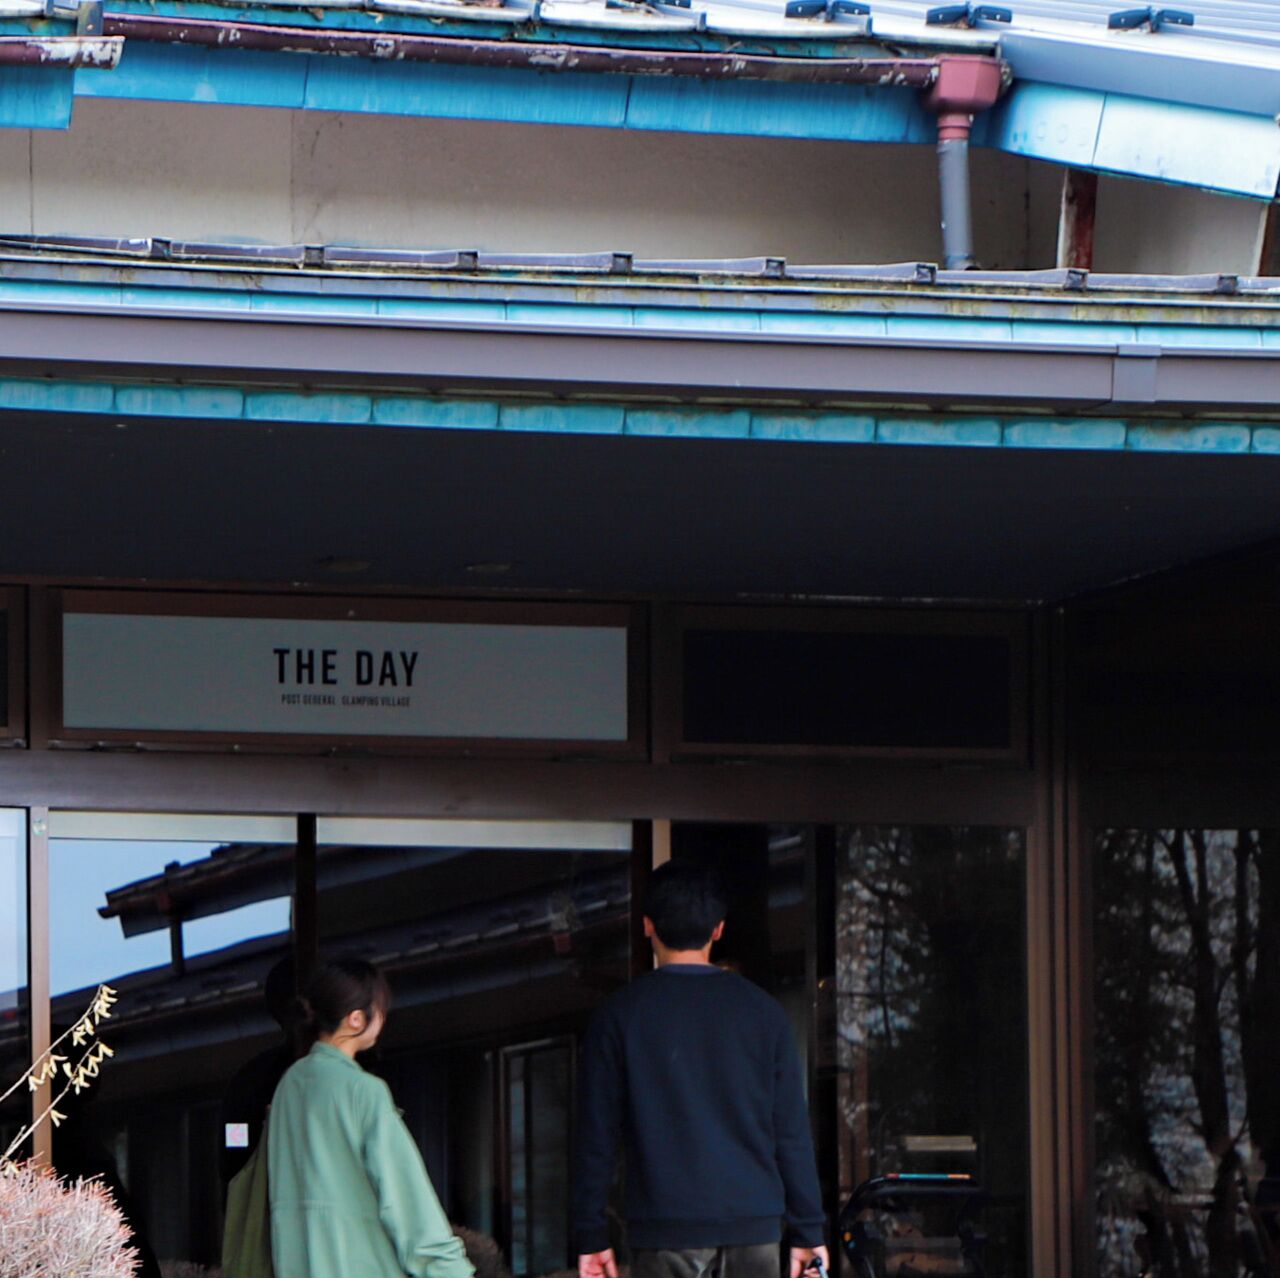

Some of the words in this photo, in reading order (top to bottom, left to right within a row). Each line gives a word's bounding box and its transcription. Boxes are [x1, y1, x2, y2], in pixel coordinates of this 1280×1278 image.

[273, 648, 338, 685] THE
[356, 650, 419, 687] DAY
[281, 694, 301, 705] POST
[381, 696, 411, 708] VILLAGE
